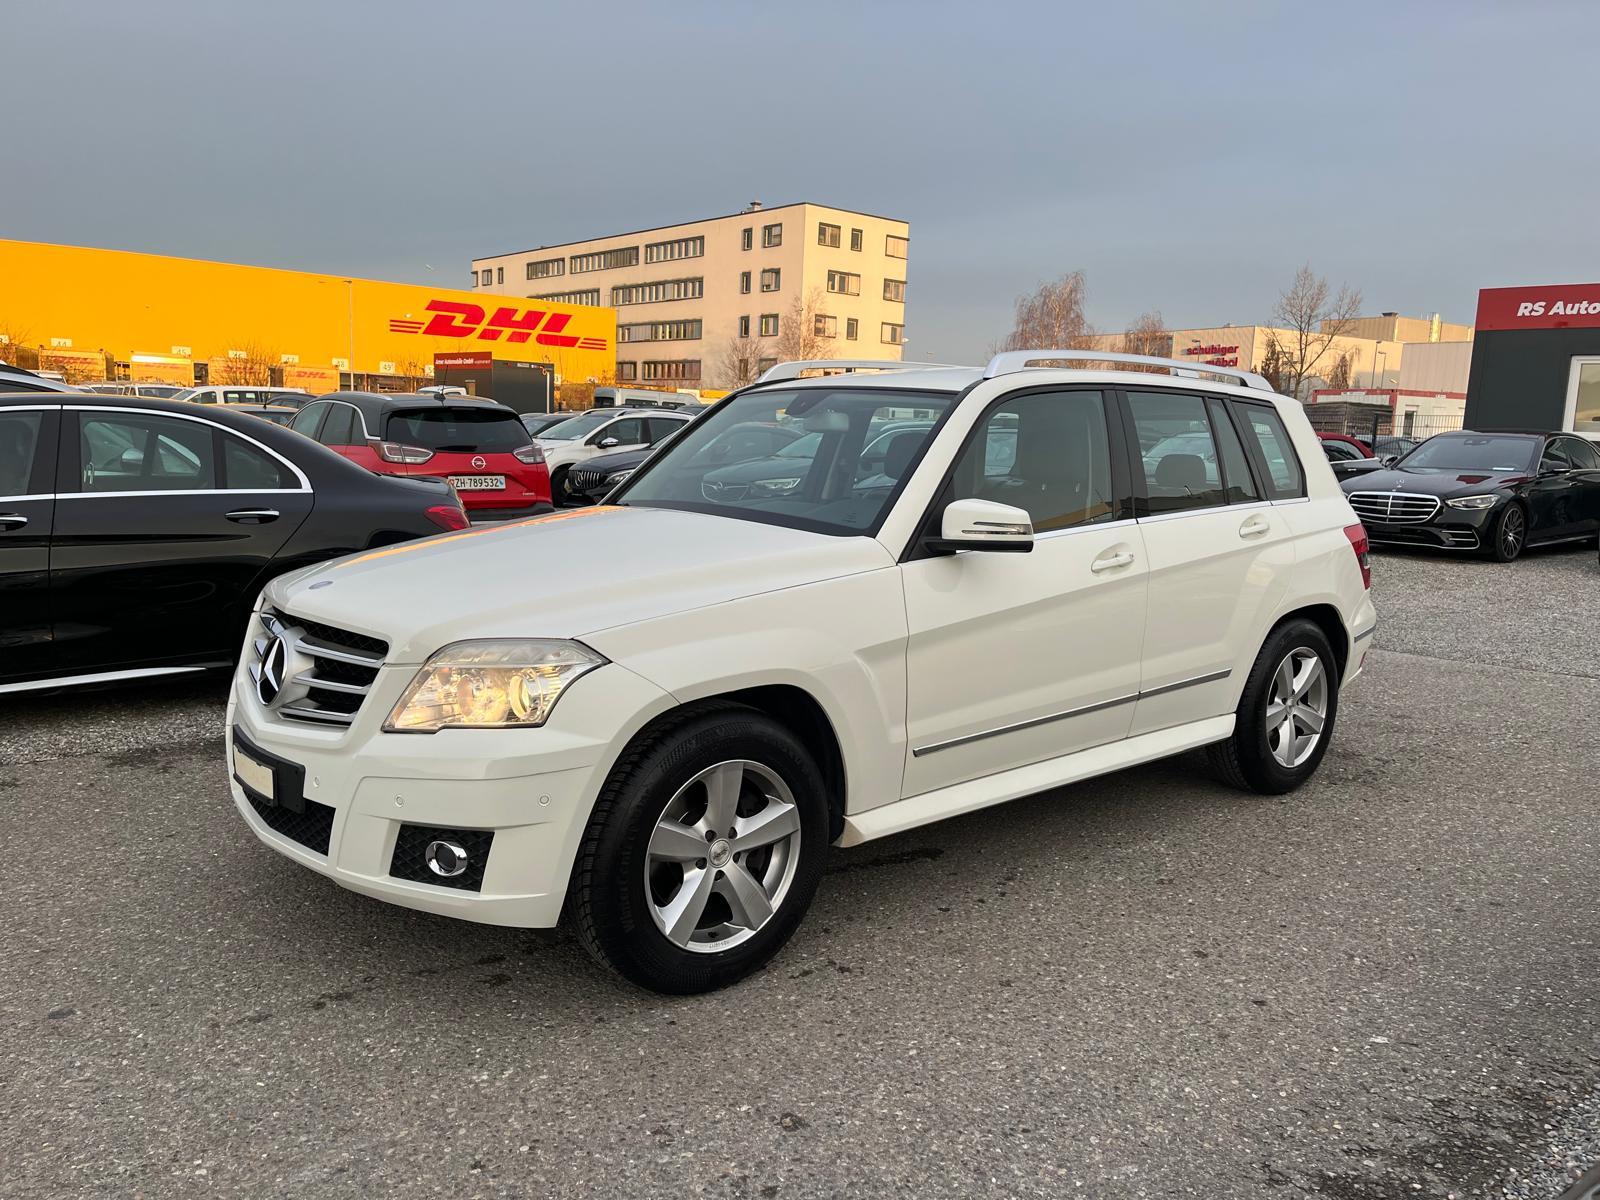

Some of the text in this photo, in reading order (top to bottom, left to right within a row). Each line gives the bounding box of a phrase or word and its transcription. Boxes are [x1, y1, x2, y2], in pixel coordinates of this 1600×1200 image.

[1517, 300, 1600, 317] RS Auto
[422, 299, 580, 348] DHL
[1186, 344, 1239, 356] schubiger
